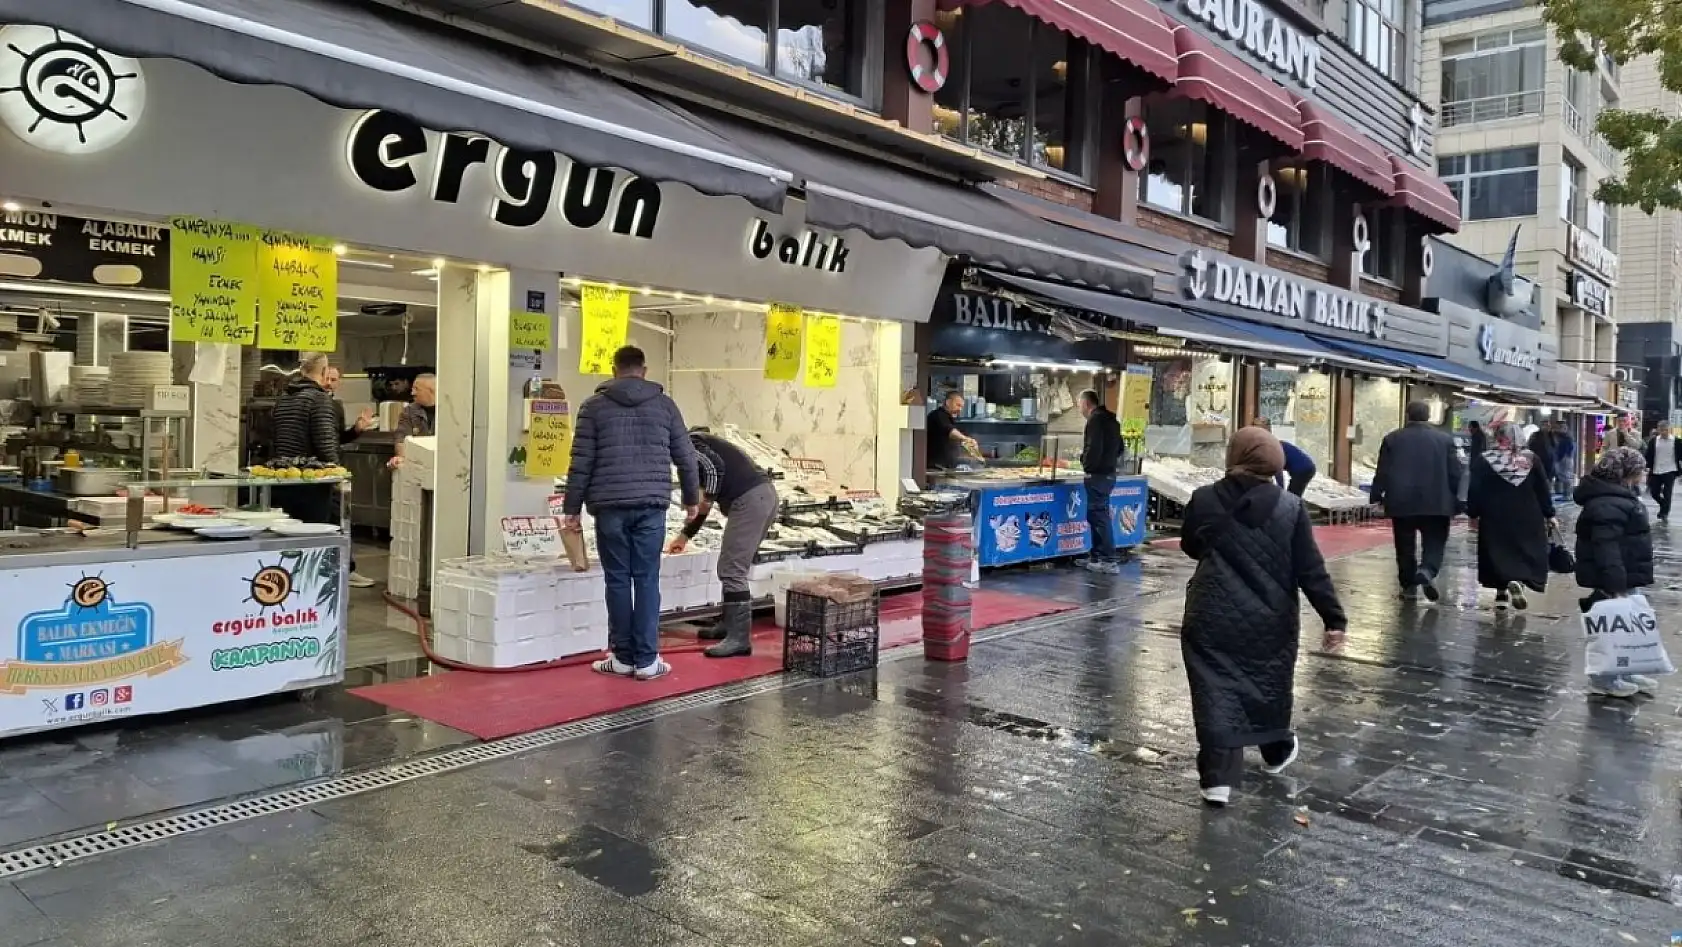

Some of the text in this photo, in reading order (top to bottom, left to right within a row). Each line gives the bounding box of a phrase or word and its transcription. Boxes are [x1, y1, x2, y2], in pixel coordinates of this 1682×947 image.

[82, 220, 162, 241] ALABALIK
[89, 238, 156, 257] EKMEK
[1213, 261, 1370, 333] DALYAN BALIK
[38, 623, 77, 642] BALIK
[212, 607, 319, 635] ergün balık
[211, 636, 320, 671] KAMPANYA
